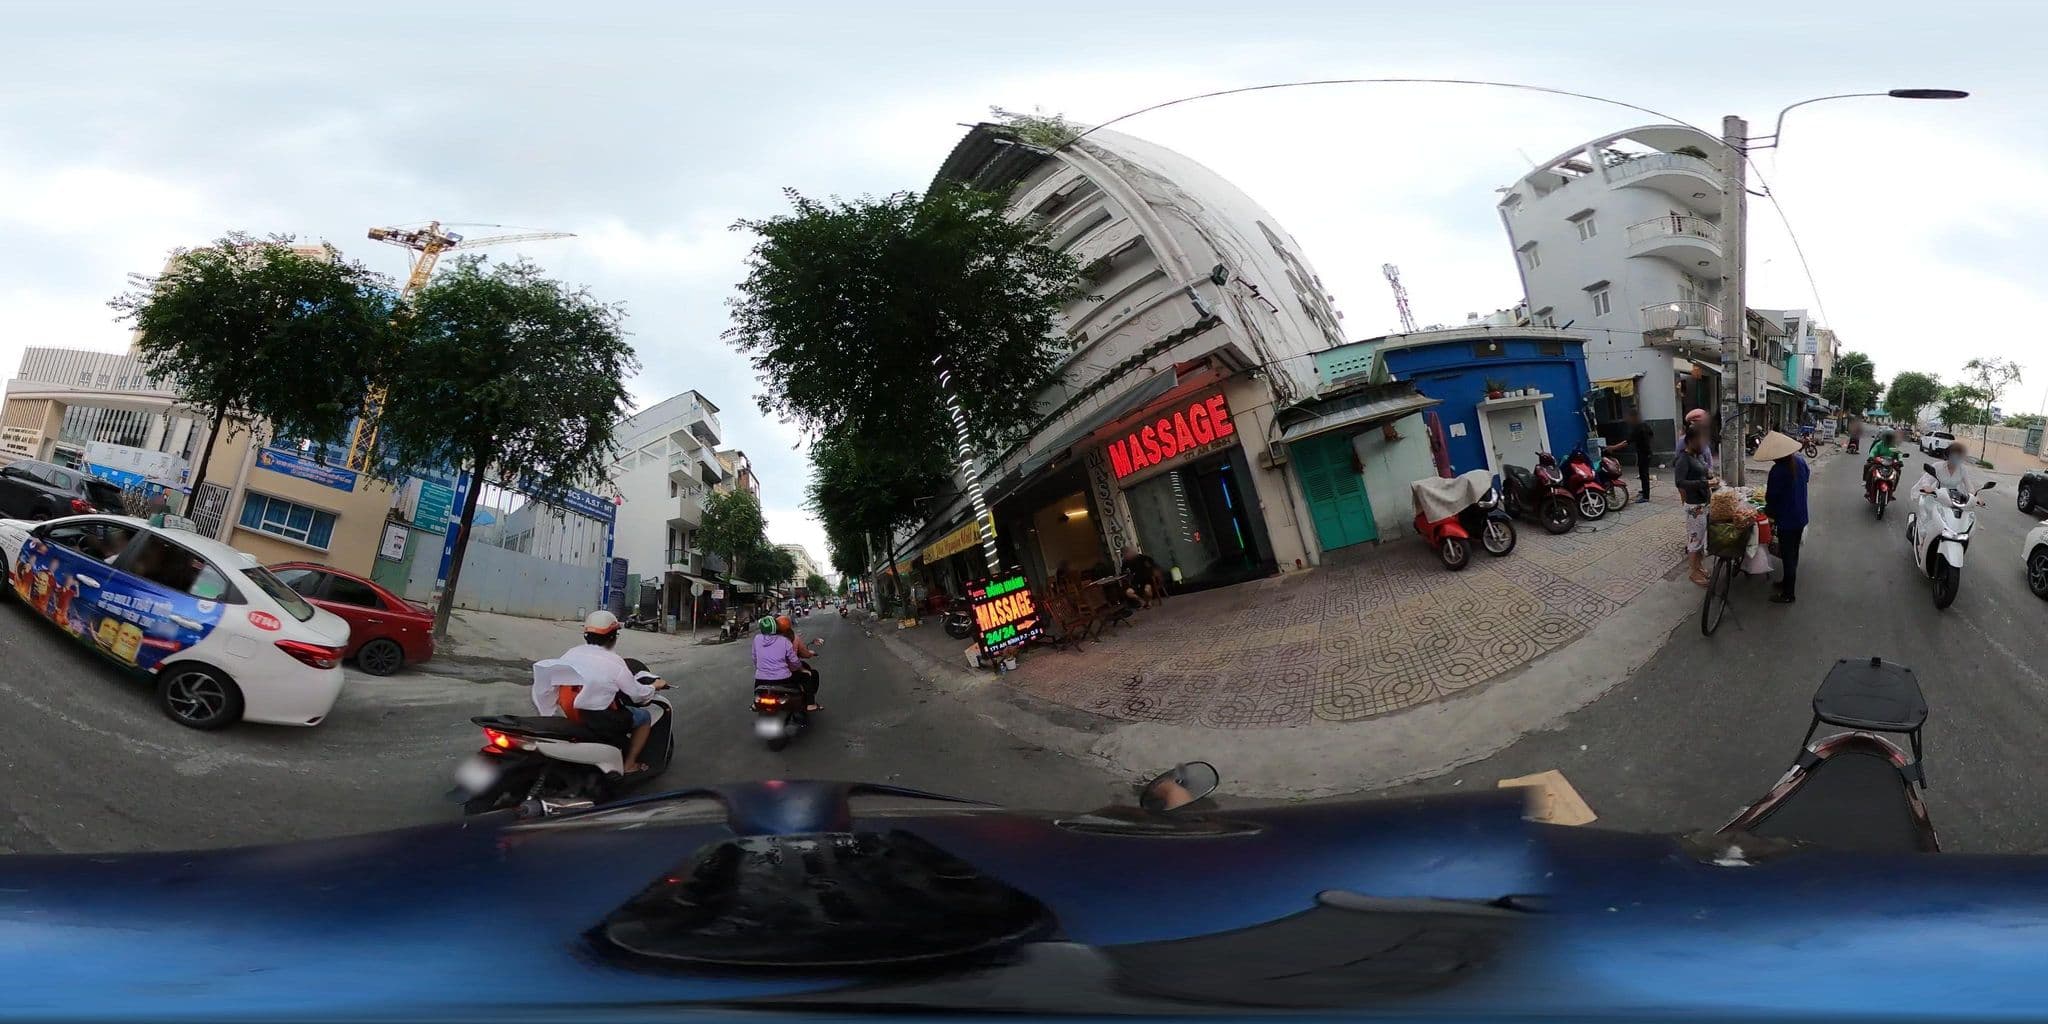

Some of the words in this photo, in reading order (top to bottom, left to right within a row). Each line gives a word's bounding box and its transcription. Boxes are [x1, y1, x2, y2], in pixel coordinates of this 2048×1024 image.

[1108, 394, 1233, 479] MASSAGE
[1087, 447, 1125, 560] MASSAG
[976, 590, 1035, 631] MASSAGE
